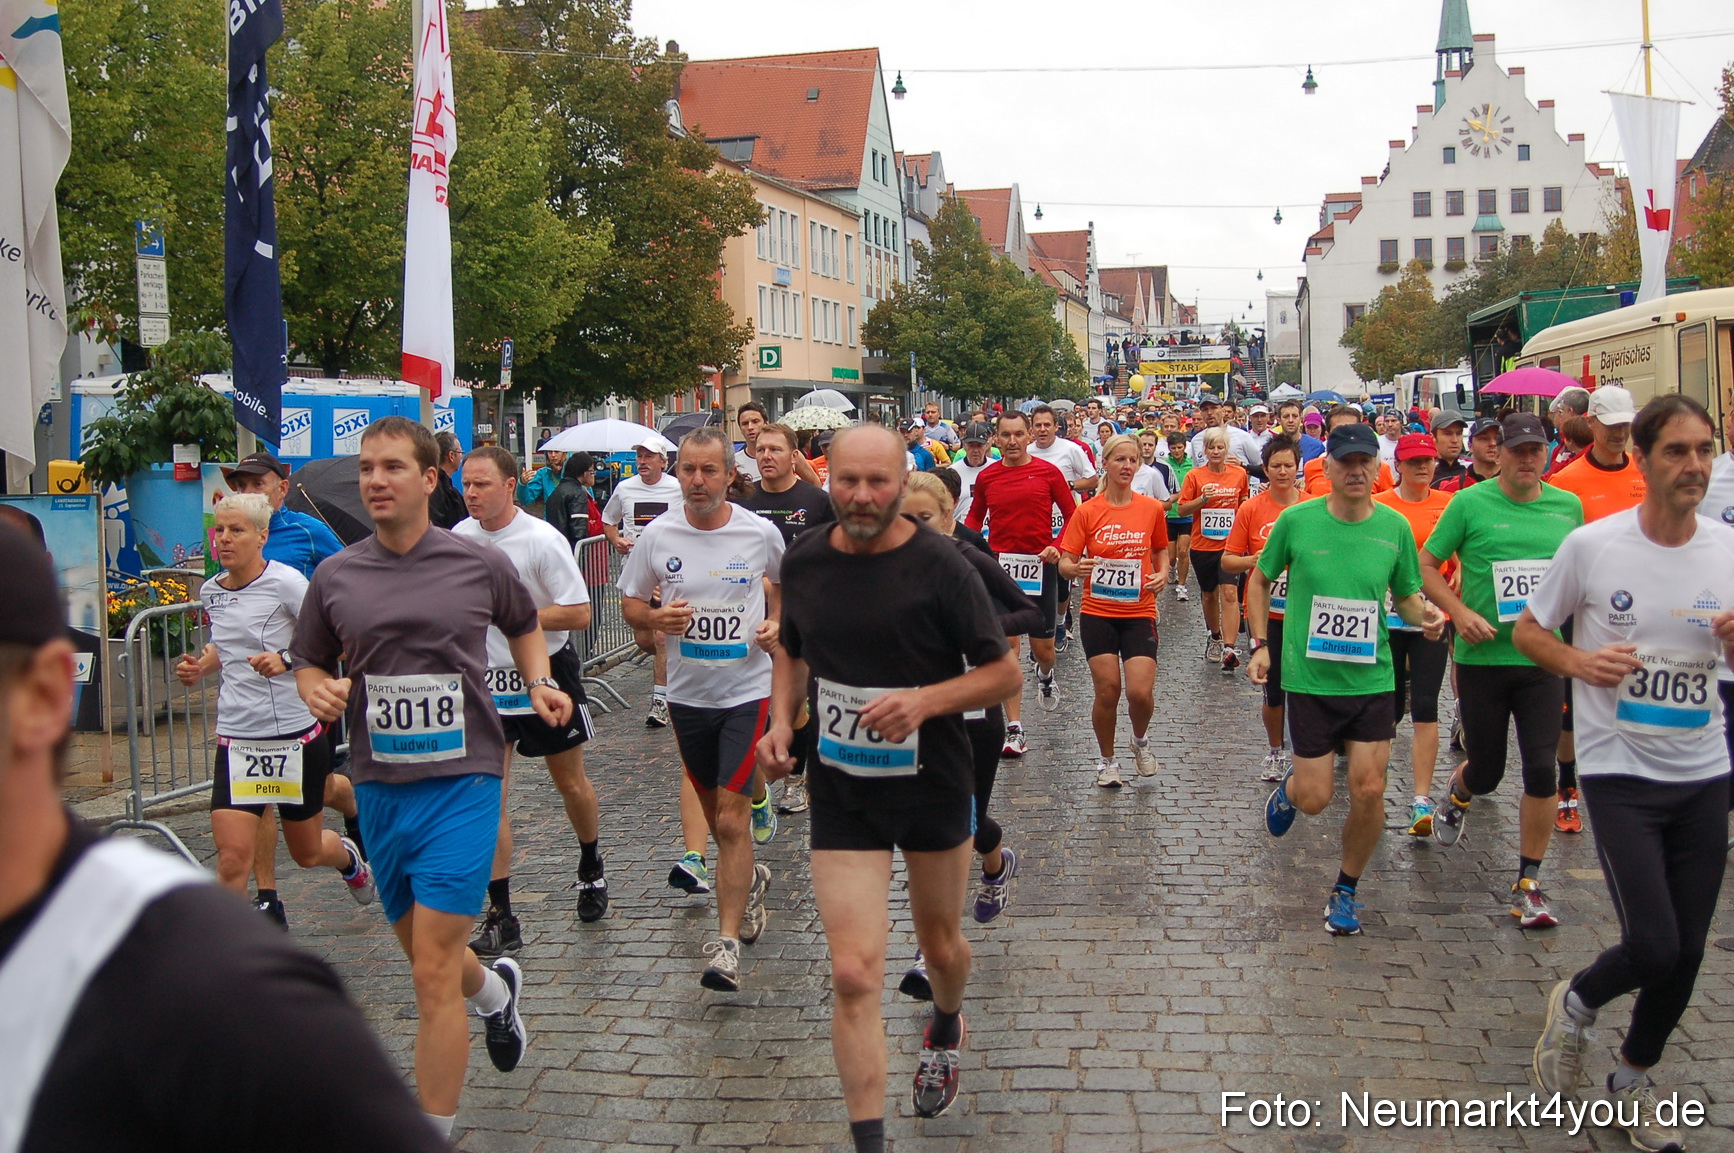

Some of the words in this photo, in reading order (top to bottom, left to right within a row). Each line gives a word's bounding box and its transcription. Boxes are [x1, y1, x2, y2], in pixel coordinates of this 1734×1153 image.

[140, 270, 164, 280] Parkschein
[143, 281, 164, 291] werktags
[762, 349, 778, 366] D
[1600, 344, 1651, 372] Bayerisches
[1169, 363, 1200, 372] START
[1204, 516, 1232, 528] 2785
[1102, 529, 1146, 541] Fischer
[1003, 563, 1039, 580] 3102
[1494, 566, 1516, 574] PARTL
[1095, 568, 1136, 587] 2781
[1313, 602, 1336, 611] PARTL
[1608, 613, 1637, 621] PARTL
[684, 616, 741, 641] 2902
[1316, 612, 1370, 638] 2821
[693, 646, 731, 657] Thomas
[1322, 641, 1362, 654] Christian
[1660, 657, 1704, 669] Neumarkt
[368, 684, 396, 694] PARTL
[398, 683, 445, 694] Neumarkt
[1628, 667, 1708, 705] 3063
[820, 687, 848, 704] PARTL
[499, 698, 519, 707] Fred
[375, 695, 455, 730] 3018
[392, 738, 438, 752] Ludwig
[838, 748, 890, 765] Gerhard
[245, 754, 287, 778] 287
[255, 783, 281, 794] Petra
